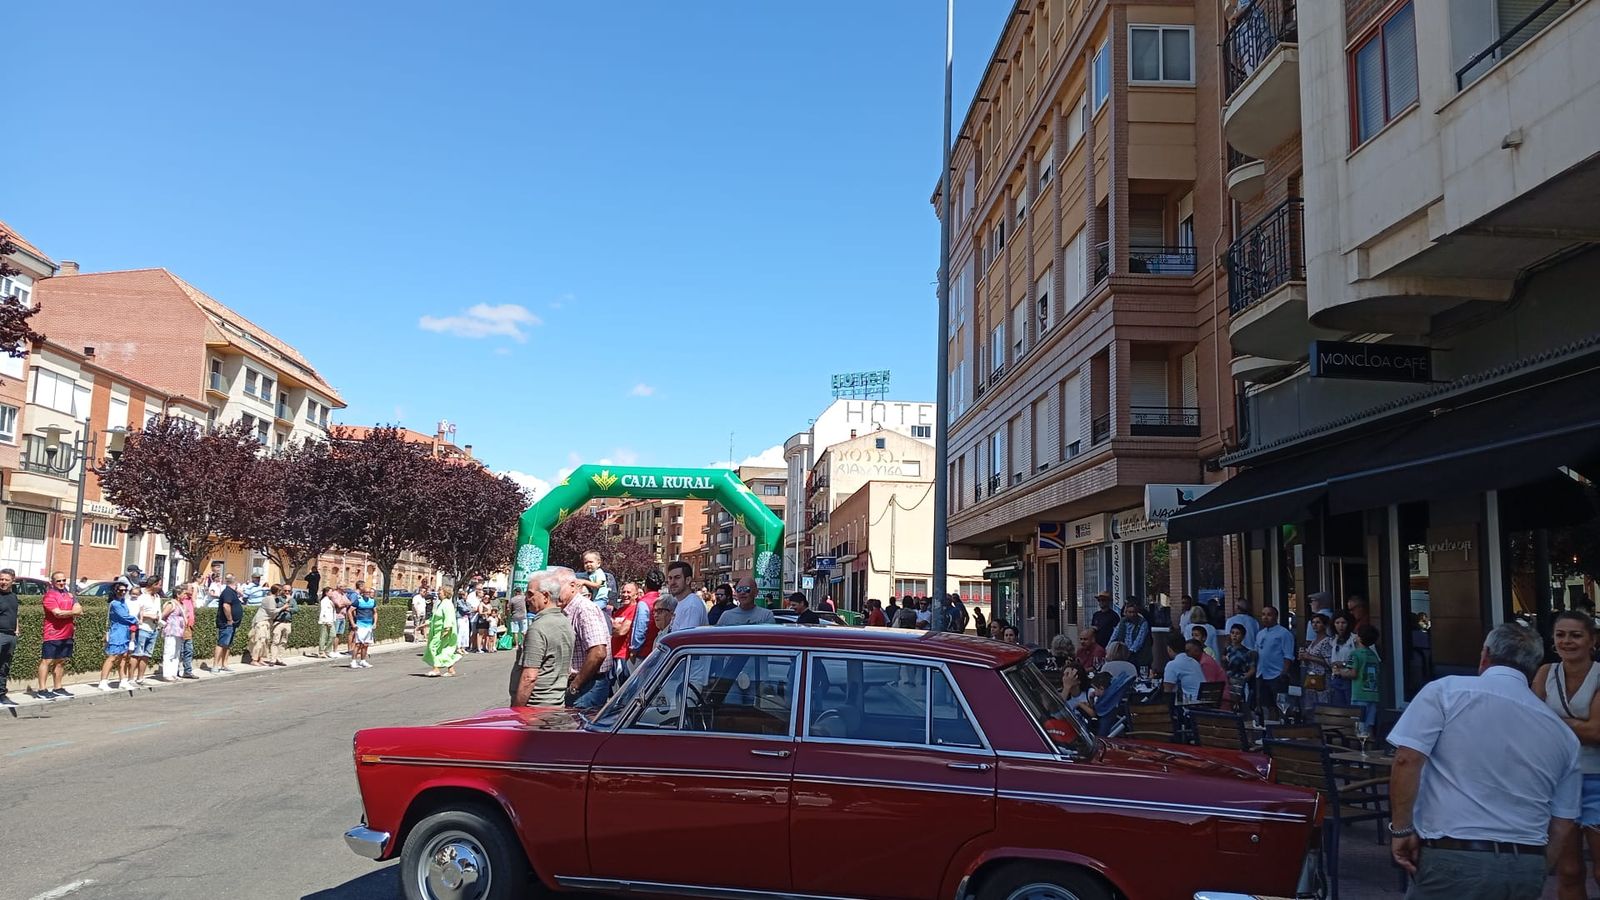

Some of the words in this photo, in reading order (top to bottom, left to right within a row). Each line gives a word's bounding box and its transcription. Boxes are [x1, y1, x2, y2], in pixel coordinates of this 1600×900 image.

[1319, 345, 1391, 375] MONCLOA
[846, 400, 933, 426] HOTE
[621, 474, 658, 488] CAJA
[662, 475, 714, 489] RURAL
[1113, 575, 1121, 606] NACHO
